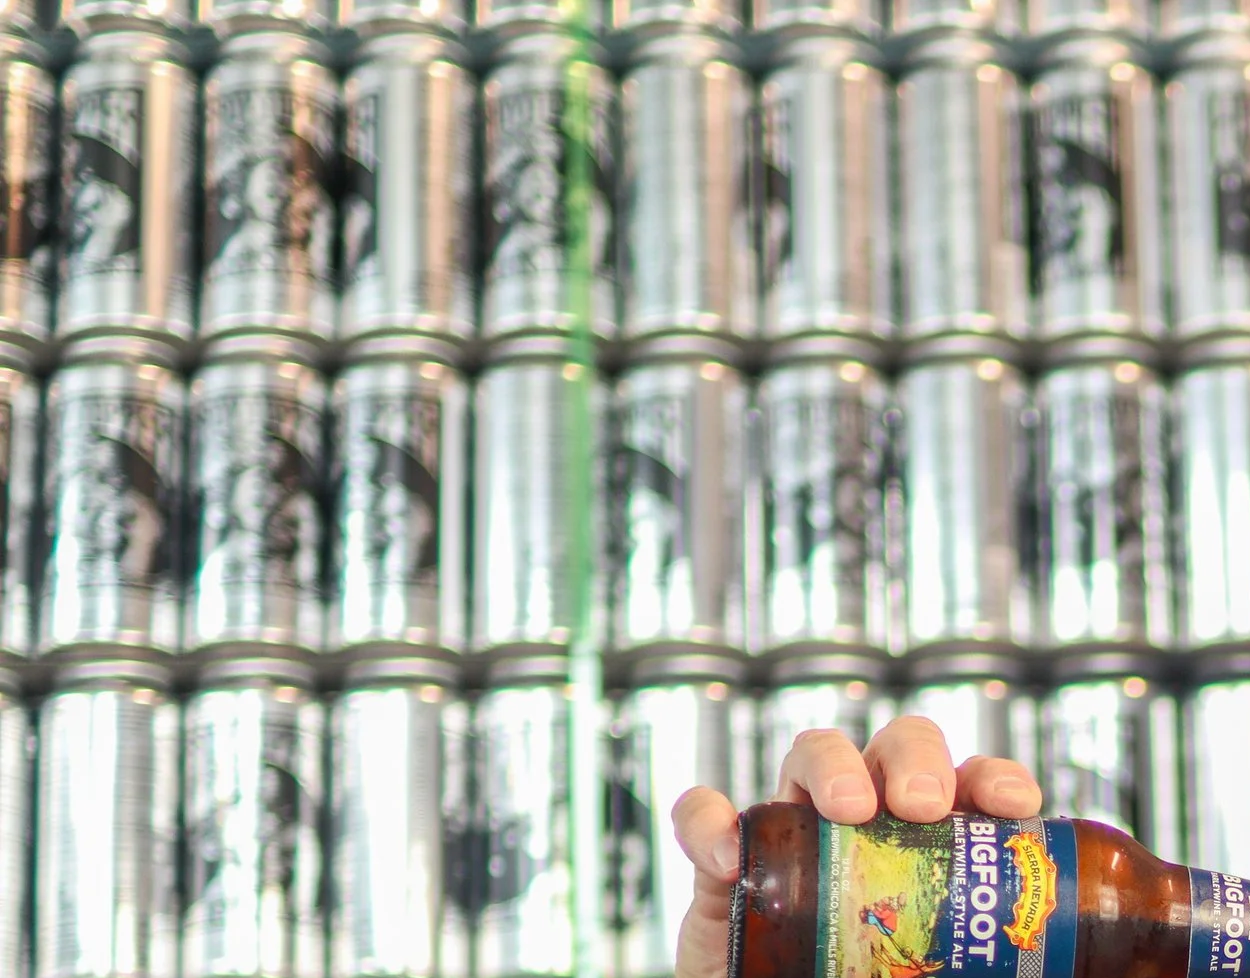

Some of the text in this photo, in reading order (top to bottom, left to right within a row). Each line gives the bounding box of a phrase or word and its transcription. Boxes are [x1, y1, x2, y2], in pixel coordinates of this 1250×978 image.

[831, 829, 840, 862] BREWING
[829, 881, 840, 910] CHICO,
[951, 817, 966, 969] BARLEYWINE STYLE ALE
[1021, 844, 1041, 931] SIERRA NEVADA
[830, 911, 840, 925] CA
[828, 934, 838, 958] MILLS
[1211, 922, 1221, 952] STYLE
[1209, 954, 1219, 972] ALE
